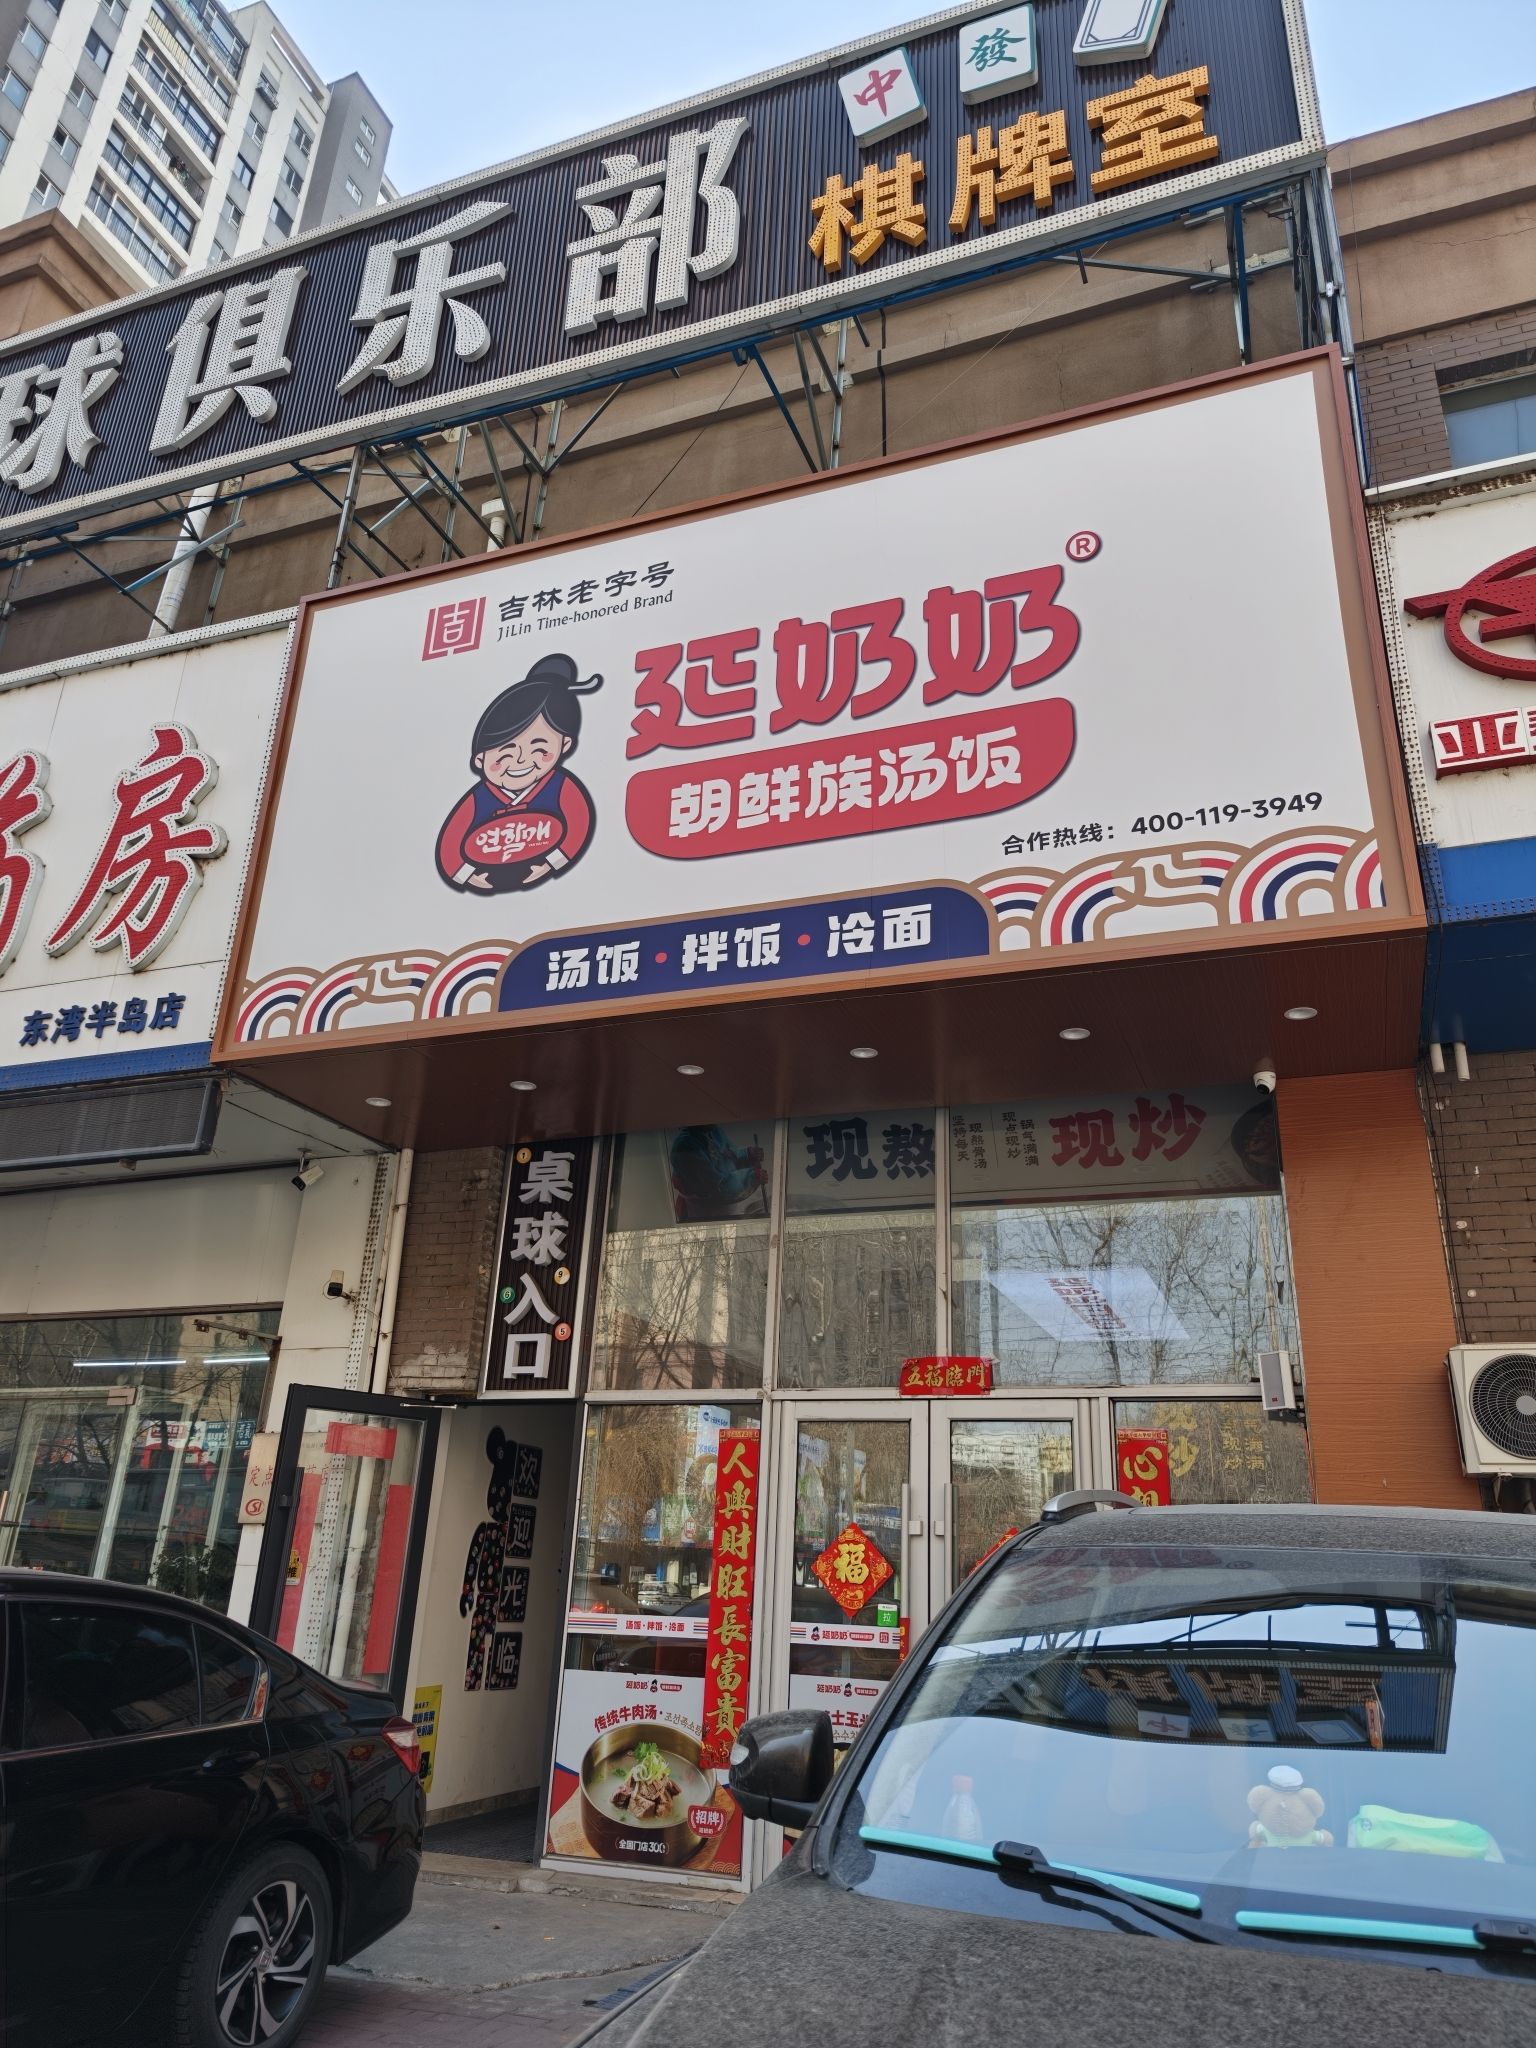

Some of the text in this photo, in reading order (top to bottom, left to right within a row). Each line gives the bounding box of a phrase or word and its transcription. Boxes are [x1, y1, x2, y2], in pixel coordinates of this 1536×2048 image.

[853, 67, 903, 117] 中
[807, 65, 1220, 273] 棋牌室
[0, 117, 750, 495] 球俱乐部
[497, 590, 673, 642] JiLin Time-honored Brand
[498, 560, 675, 622] 吉林老字号
[626, 564, 1082, 760] 延奶奶
[669, 727, 1022, 839] 朝鲜族汤饭
[1131, 790, 1324, 836] 400-119-3949
[19, 992, 187, 1047] 东湾半岛店
[803, 1116, 935, 1182] 现熬
[1048, 1093, 1207, 1169] 现炒
[503, 1150, 575, 1379] 桌球入口
[498, 1448, 538, 1675] 欢迎光临
[834, 1543, 869, 1585] 福
[594, 1704, 657, 1733] 传统牛肉汤
[695, 1809, 720, 1827] 招牌
